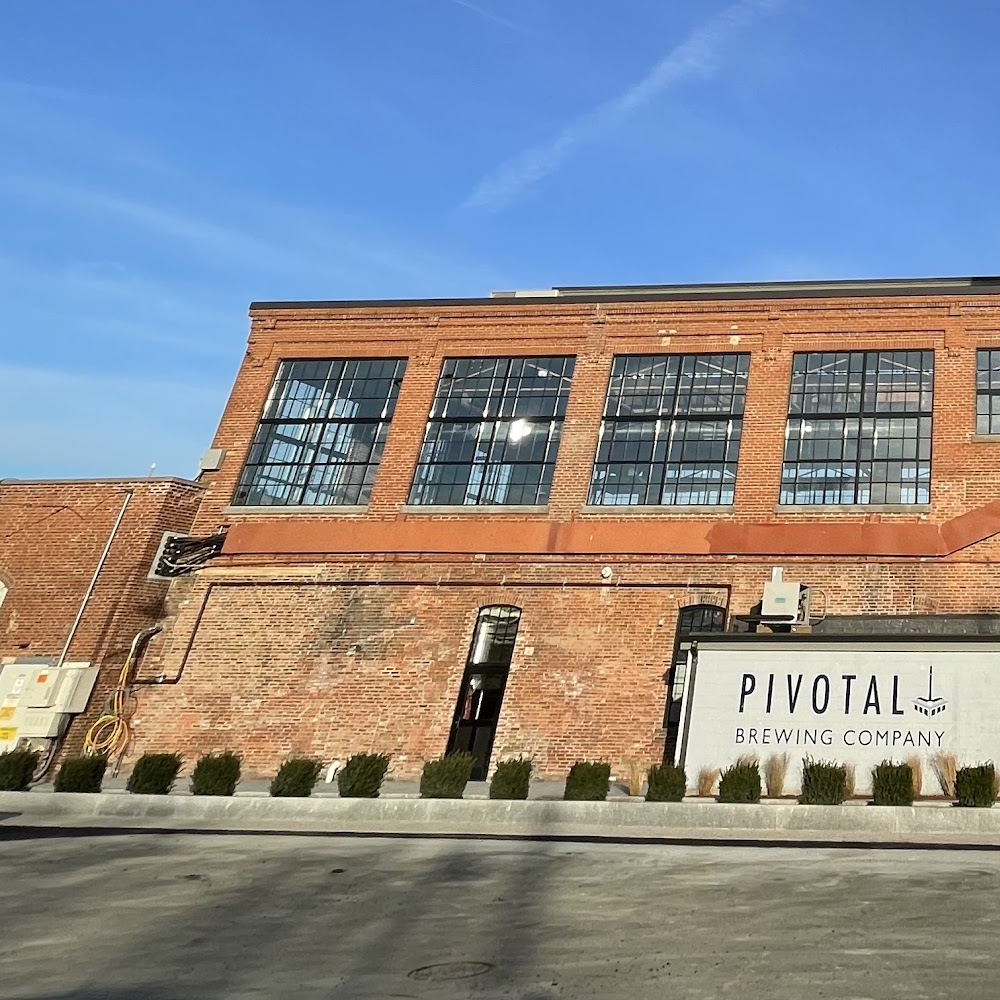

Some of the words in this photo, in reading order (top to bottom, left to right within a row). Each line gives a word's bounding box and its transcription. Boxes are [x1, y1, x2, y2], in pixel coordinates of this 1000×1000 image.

[738, 673, 904, 715] PIVOTAL
[735, 728, 833, 745] BREWING
[843, 729, 945, 747] COMPANY
